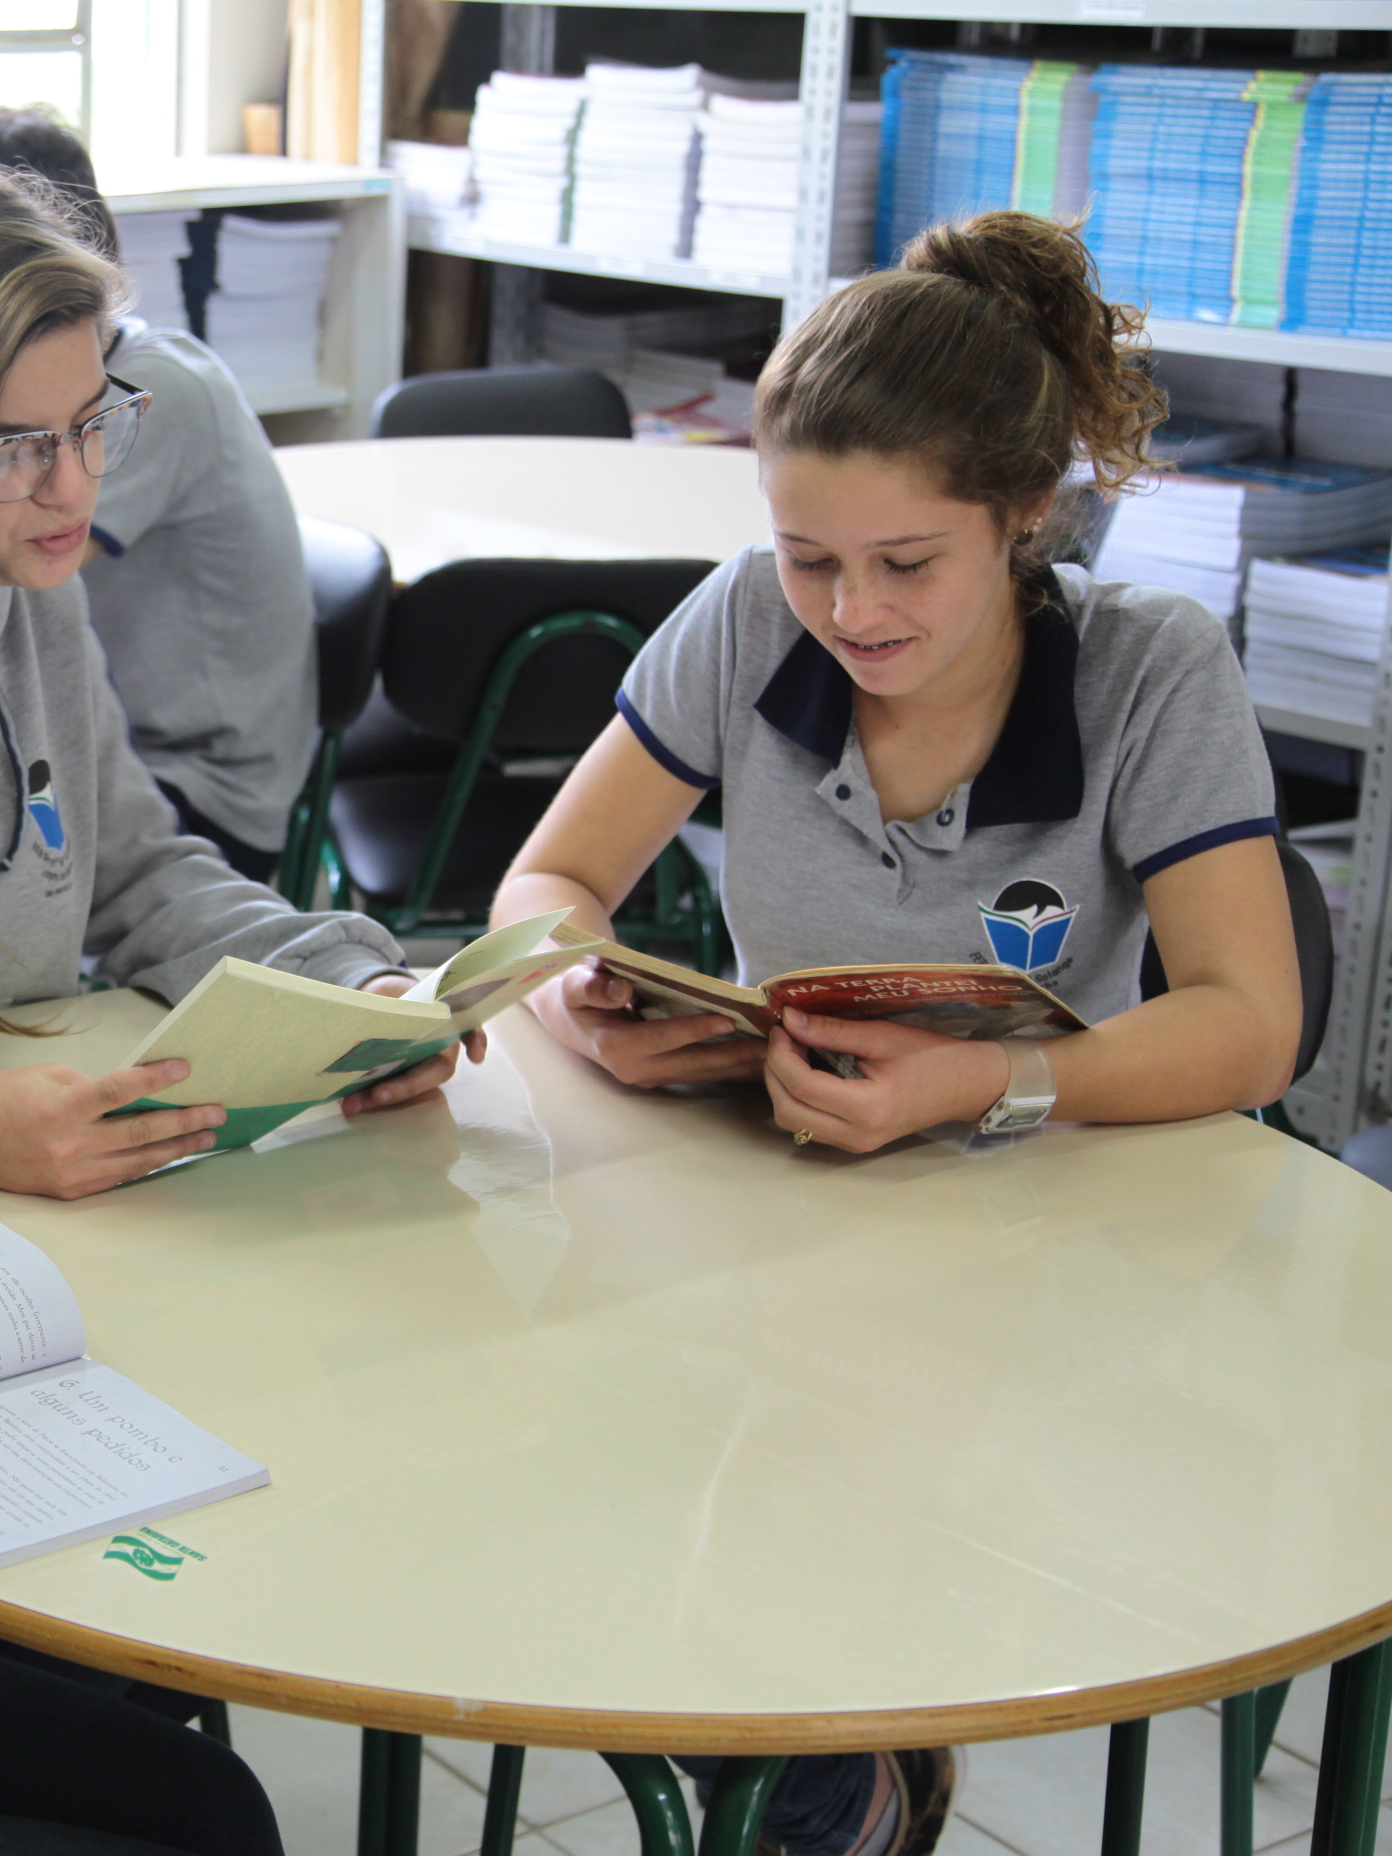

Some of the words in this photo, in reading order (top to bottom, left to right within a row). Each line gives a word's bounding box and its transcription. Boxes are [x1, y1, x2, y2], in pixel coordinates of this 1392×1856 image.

[1035, 956, 1074, 983] Solange
[787, 985, 830, 997] NA
[834, 976, 921, 987] TERRA
[854, 991, 908, 1002] MEU
[918, 985, 1023, 996] SONHO
[871, 979, 978, 992] PLANTEI
[10, 1277, 19, 1286] não
[19, 1287, 34, 1309] escolho
[0, 1281, 16, 1301] decisão.
[15, 1303, 25, 1318] Meu
[21, 1319, 32, 1330] pai
[7, 1311, 18, 1330] tenha
[30, 1388, 87, 1426] alguns
[81, 1428, 152, 1472] pedidos
[59, 1380, 80, 1391] 6.
[78, 1390, 109, 1413] Um
[105, 1415, 168, 1454] pombo
[168, 1455, 183, 1464] e
[139, 1527, 180, 1548] CATARINA
[178, 1546, 208, 1562] SANTA
